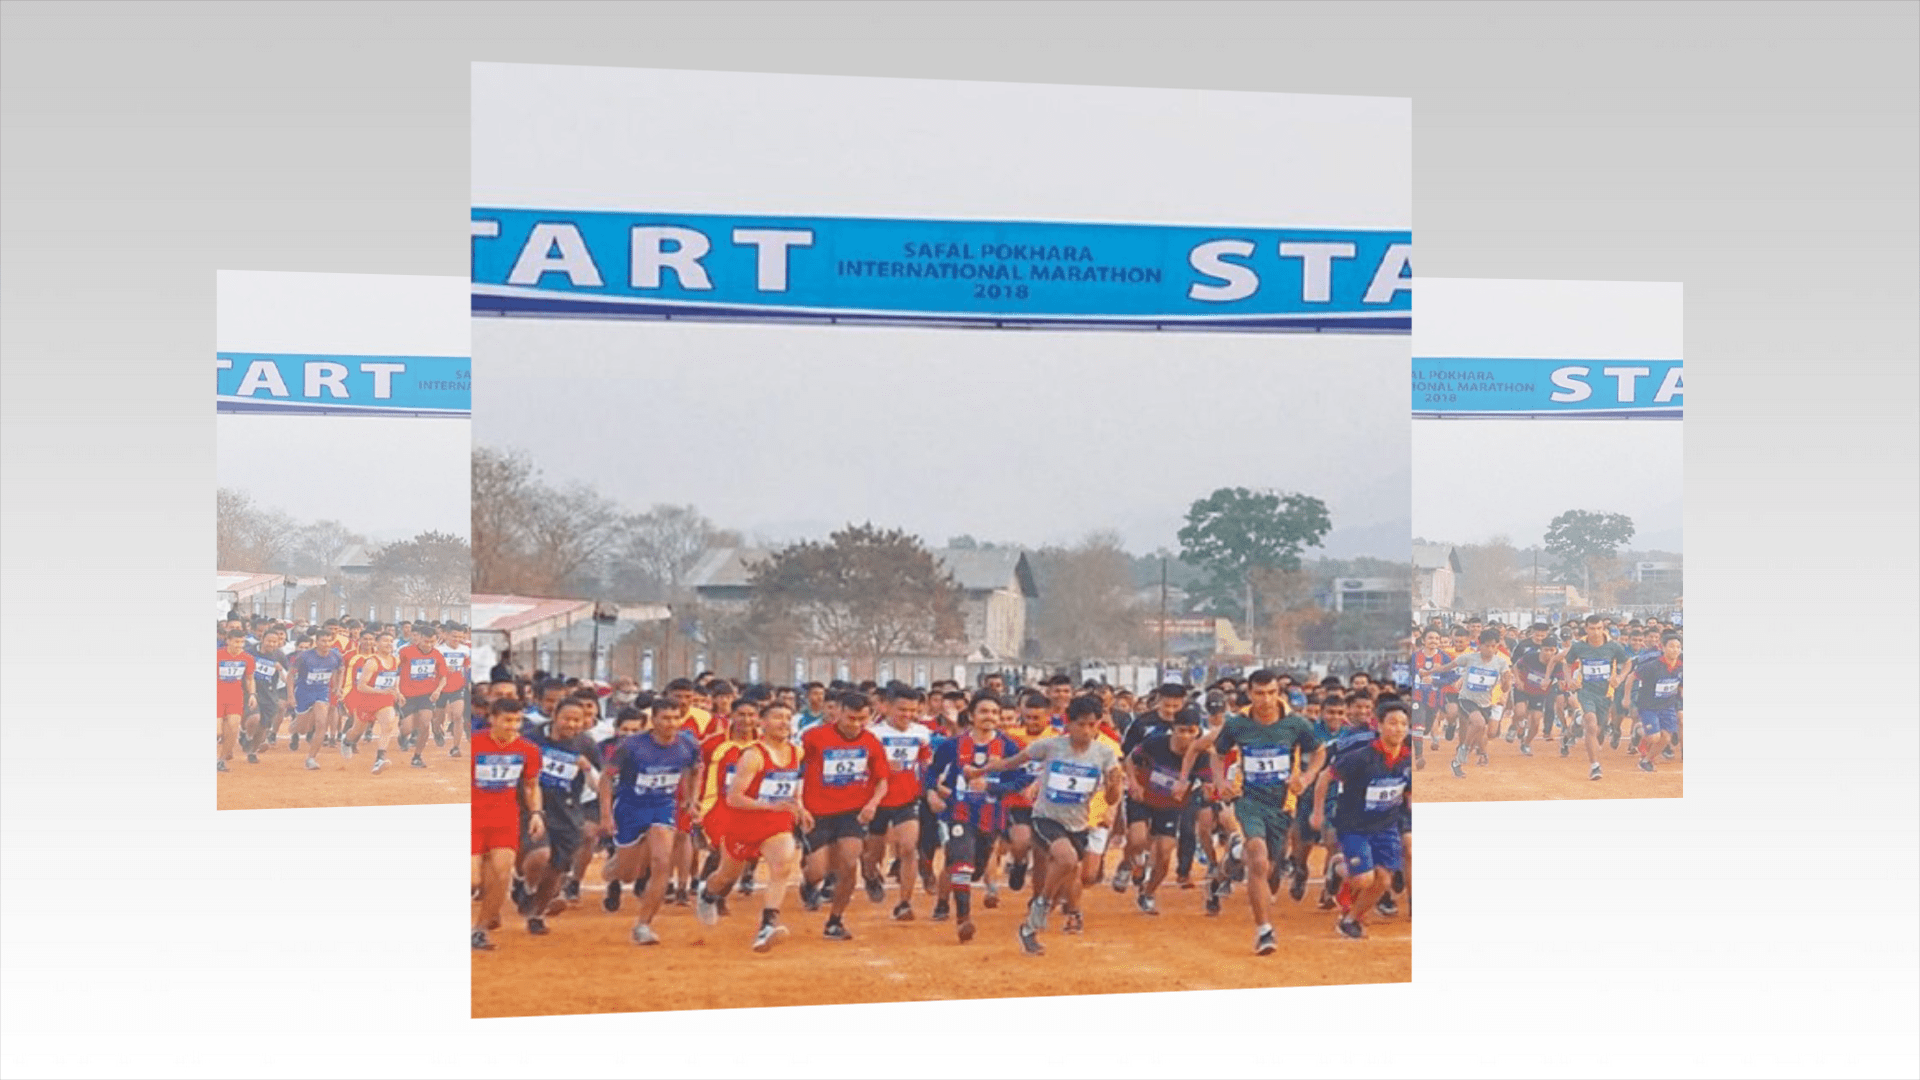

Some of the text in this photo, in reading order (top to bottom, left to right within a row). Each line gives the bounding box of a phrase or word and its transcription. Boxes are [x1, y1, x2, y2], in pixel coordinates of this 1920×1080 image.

[903, 241, 1094, 262] SAFAL POKHARA
[837, 260, 1162, 283] INTERNATIONAL MARATHON
[973, 283, 1029, 300] 2018
[1429, 370, 1495, 380] POKHARA
[1457, 382, 1535, 393] MARATHON
[1425, 393, 1457, 403] 2018
[546, 760, 565, 775] 44
[835, 760, 855, 773] 62
[1257, 759, 1274, 771] 31
[491, 766, 509, 779] 17
[1067, 776, 1078, 790] 2
